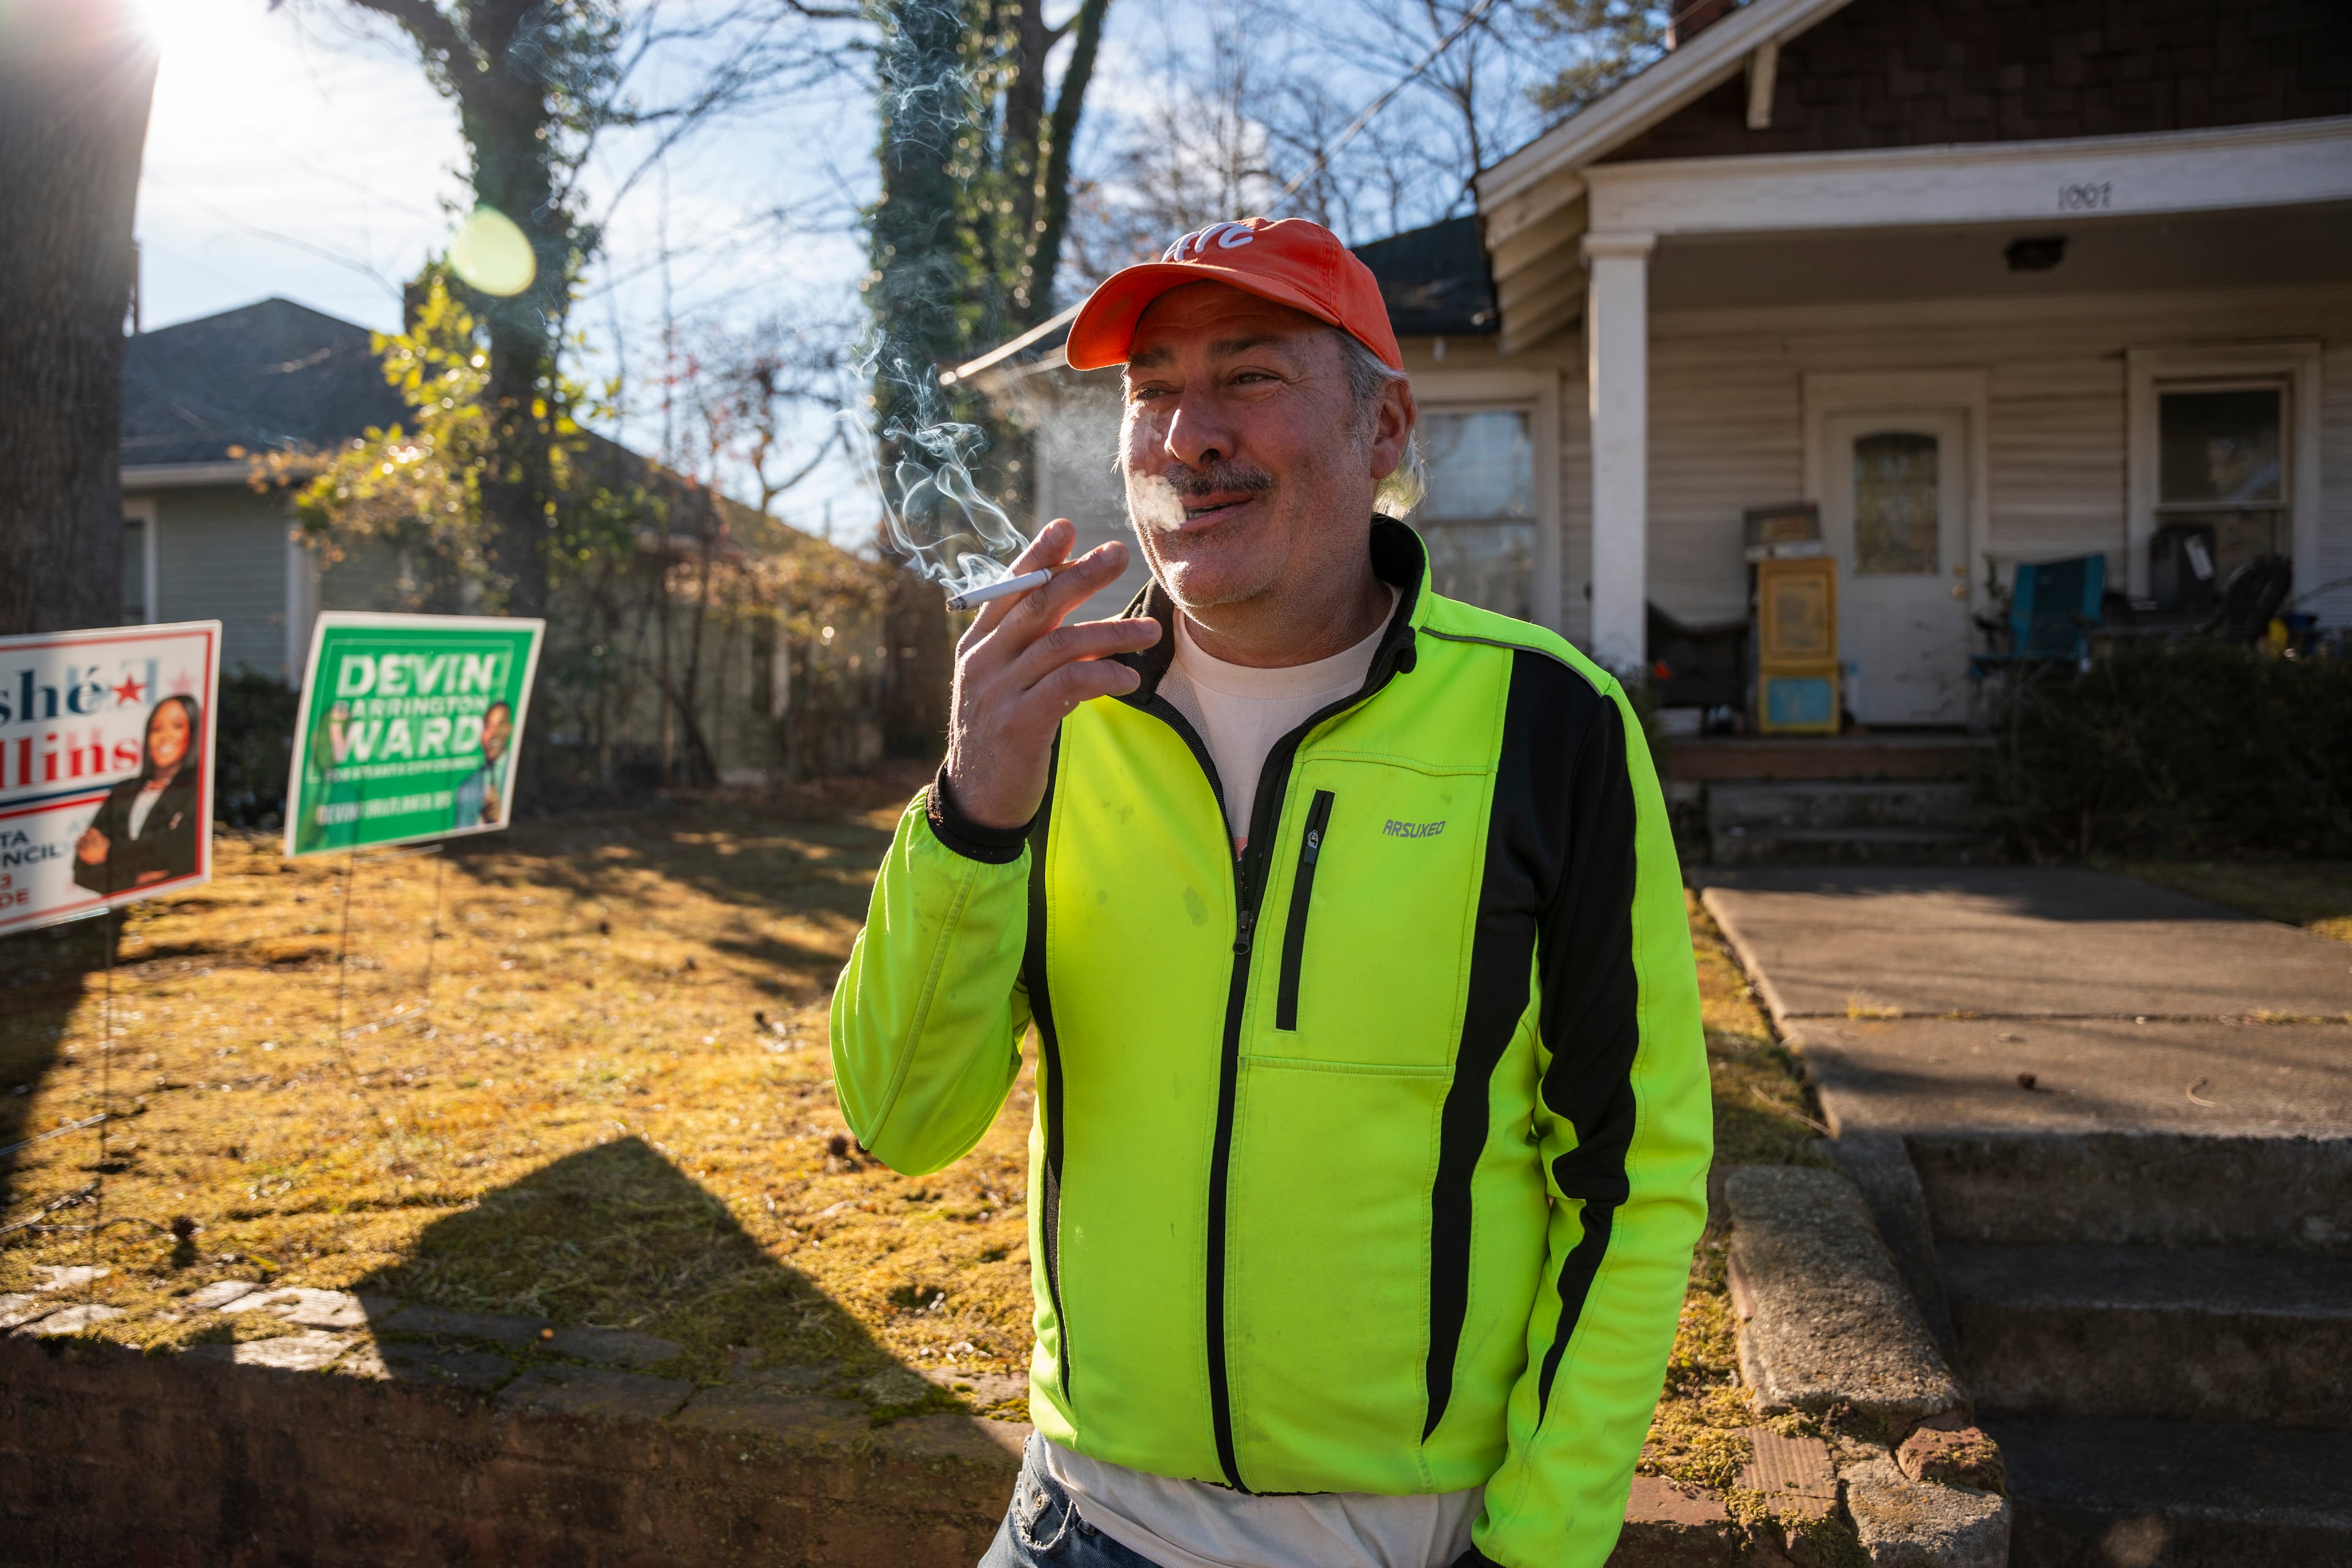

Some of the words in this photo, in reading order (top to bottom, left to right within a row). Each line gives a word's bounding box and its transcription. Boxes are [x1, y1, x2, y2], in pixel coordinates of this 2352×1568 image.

[336, 654, 496, 698] DEVIN
[330, 715, 484, 763] WARD
[1382, 819, 1446, 838] ARSUXEO
[2, 842, 63, 869] NCIL
